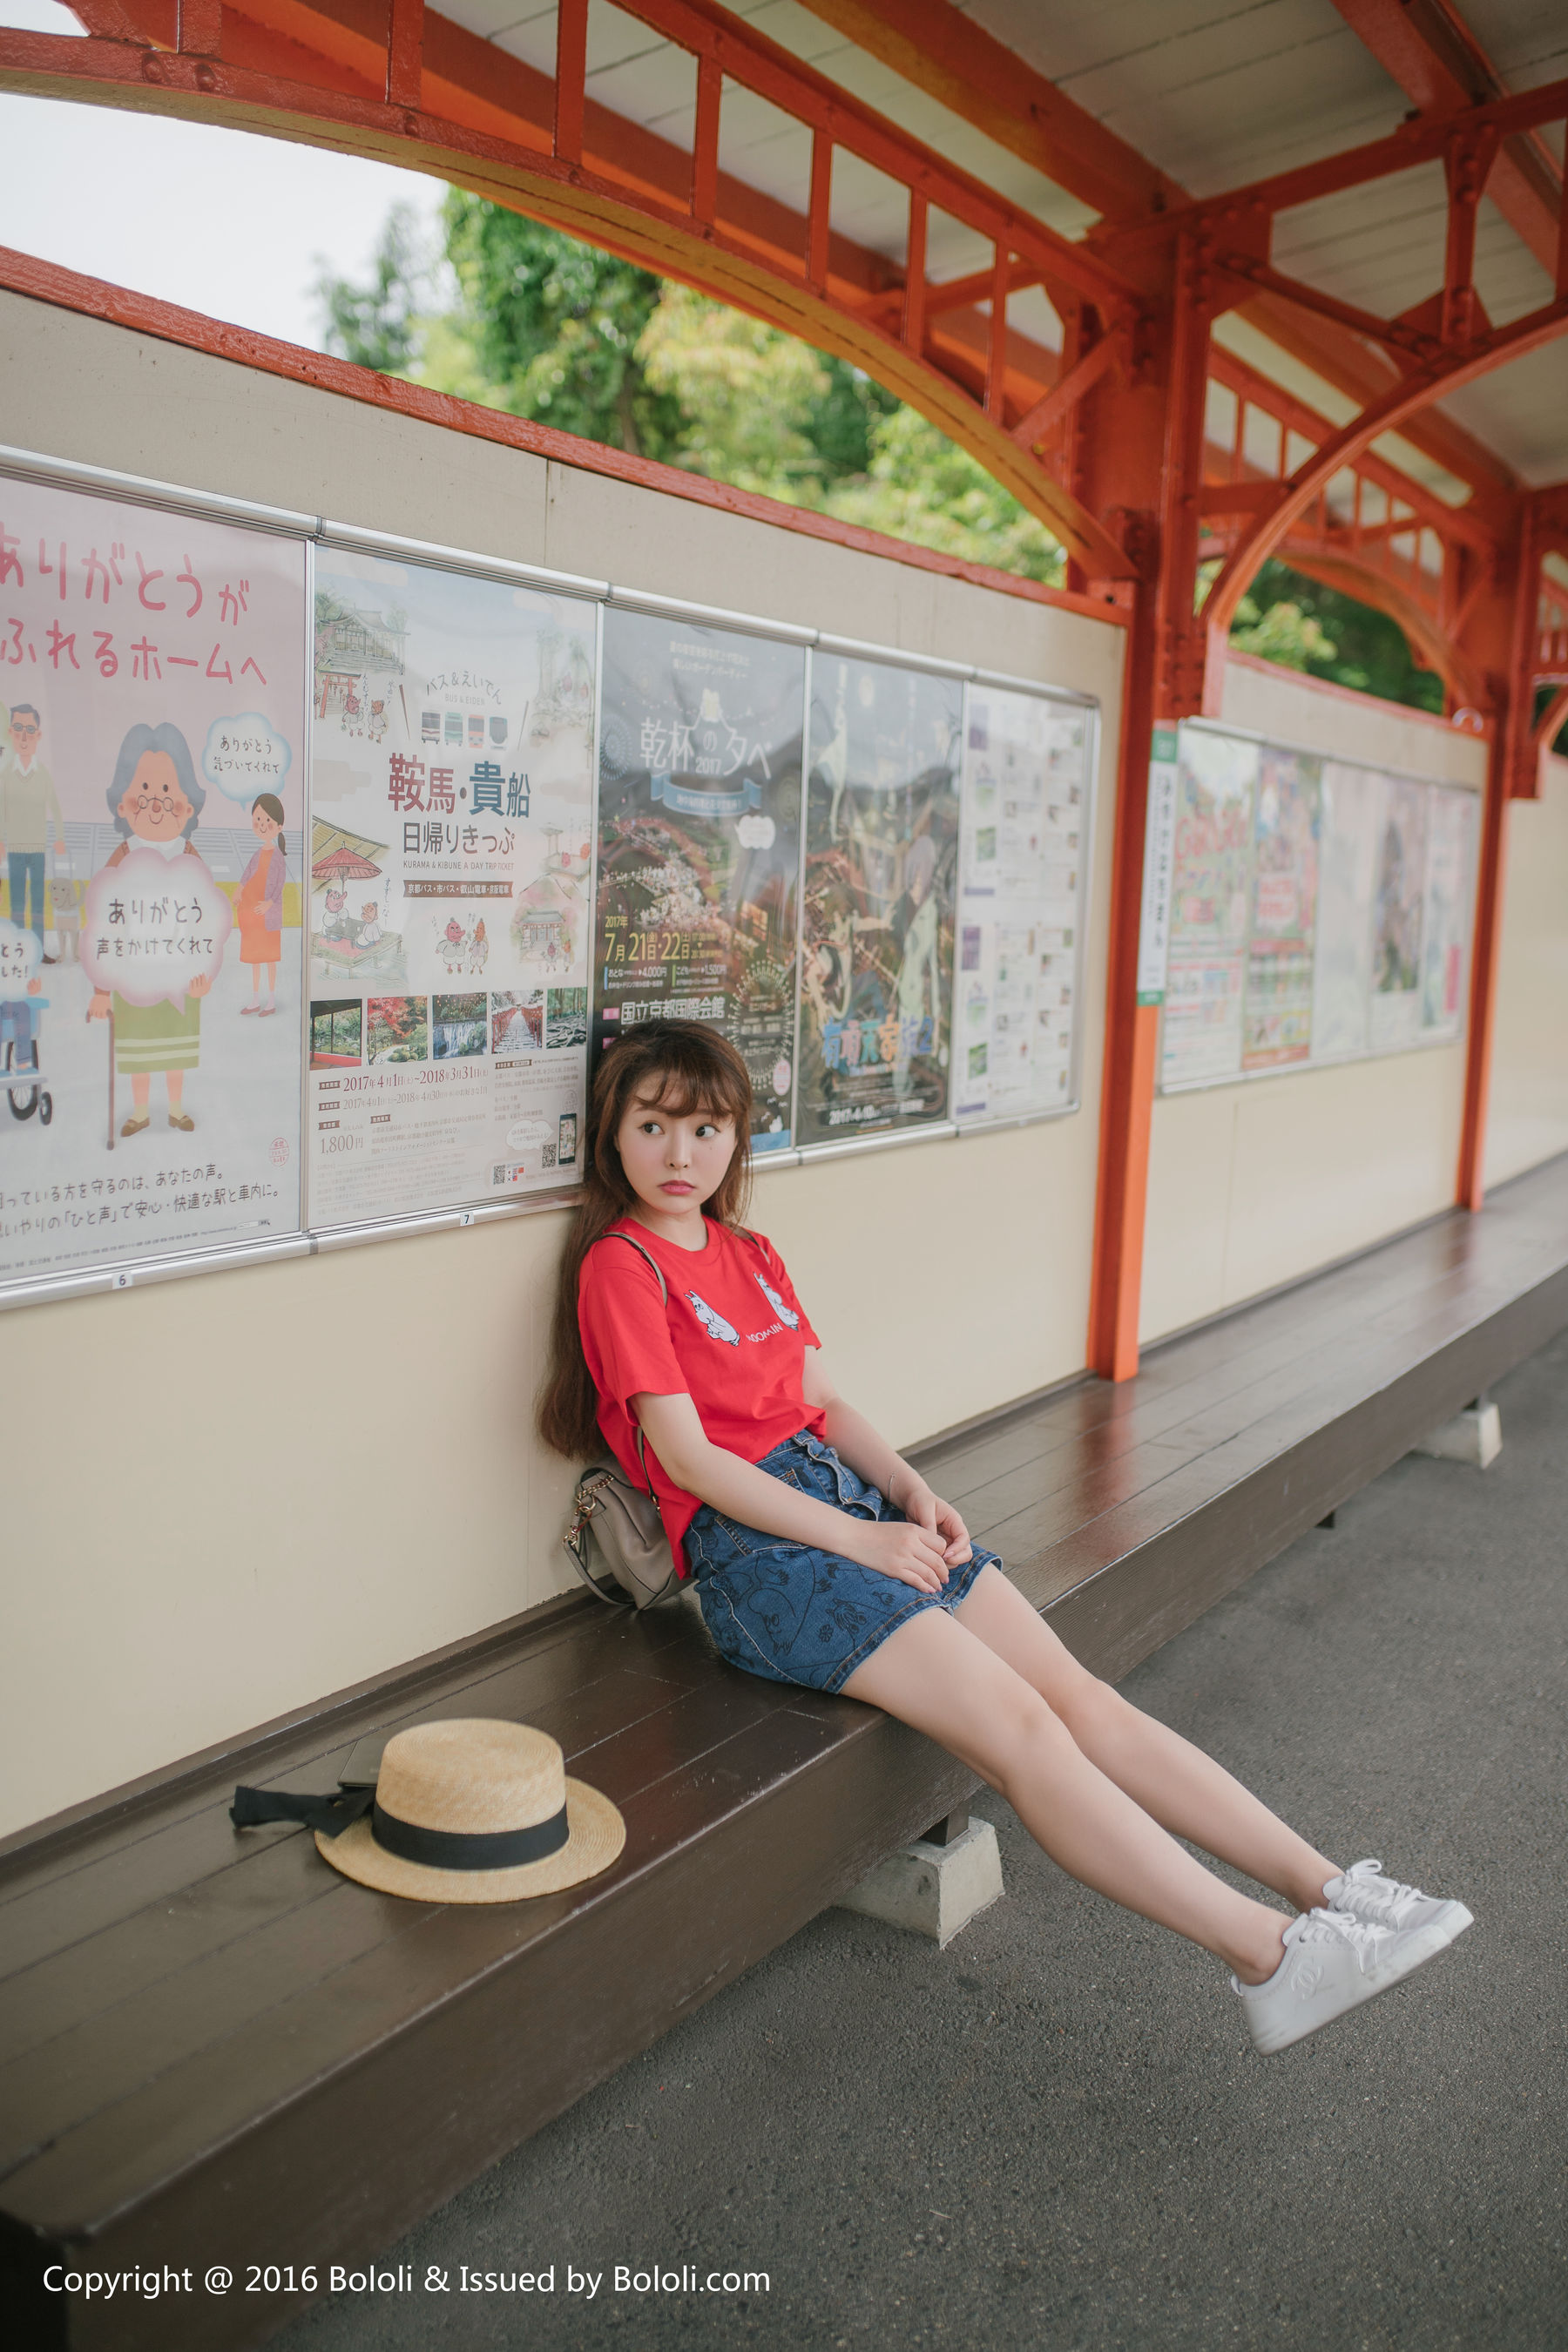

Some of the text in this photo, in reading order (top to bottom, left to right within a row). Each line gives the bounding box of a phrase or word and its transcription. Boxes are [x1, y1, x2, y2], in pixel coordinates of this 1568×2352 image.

[0, 521, 249, 625] ありがとうが
[0, 619, 267, 685] ふれるホームへ
[220, 736, 272, 754] ありがとう
[213, 756, 280, 774] 気づいてくれて
[696, 756, 721, 774] 2017
[388, 753, 531, 818] 鞍馬・貴船
[403, 821, 516, 855] 日帰りきっぷ
[403, 860, 430, 869] KURAMA
[437, 861, 462, 869] KIBUNE
[463, 861, 469, 869] A
[470, 861, 483, 870] DAY
[485, 862, 497, 871] TRIP
[498, 862, 514, 871] TICKET
[109, 897, 203, 925] ありがとう
[605, 916, 628, 929] 2017年
[97, 937, 213, 959] 声をかけてくれて
[321, 1135, 363, 1155] 1,800円
[0, 1182, 278, 1238] いやりの「ひと声」で安心・快適な駅と車内に。
[464, 1214, 470, 1224] 7
[119, 1274, 126, 1287] 6
